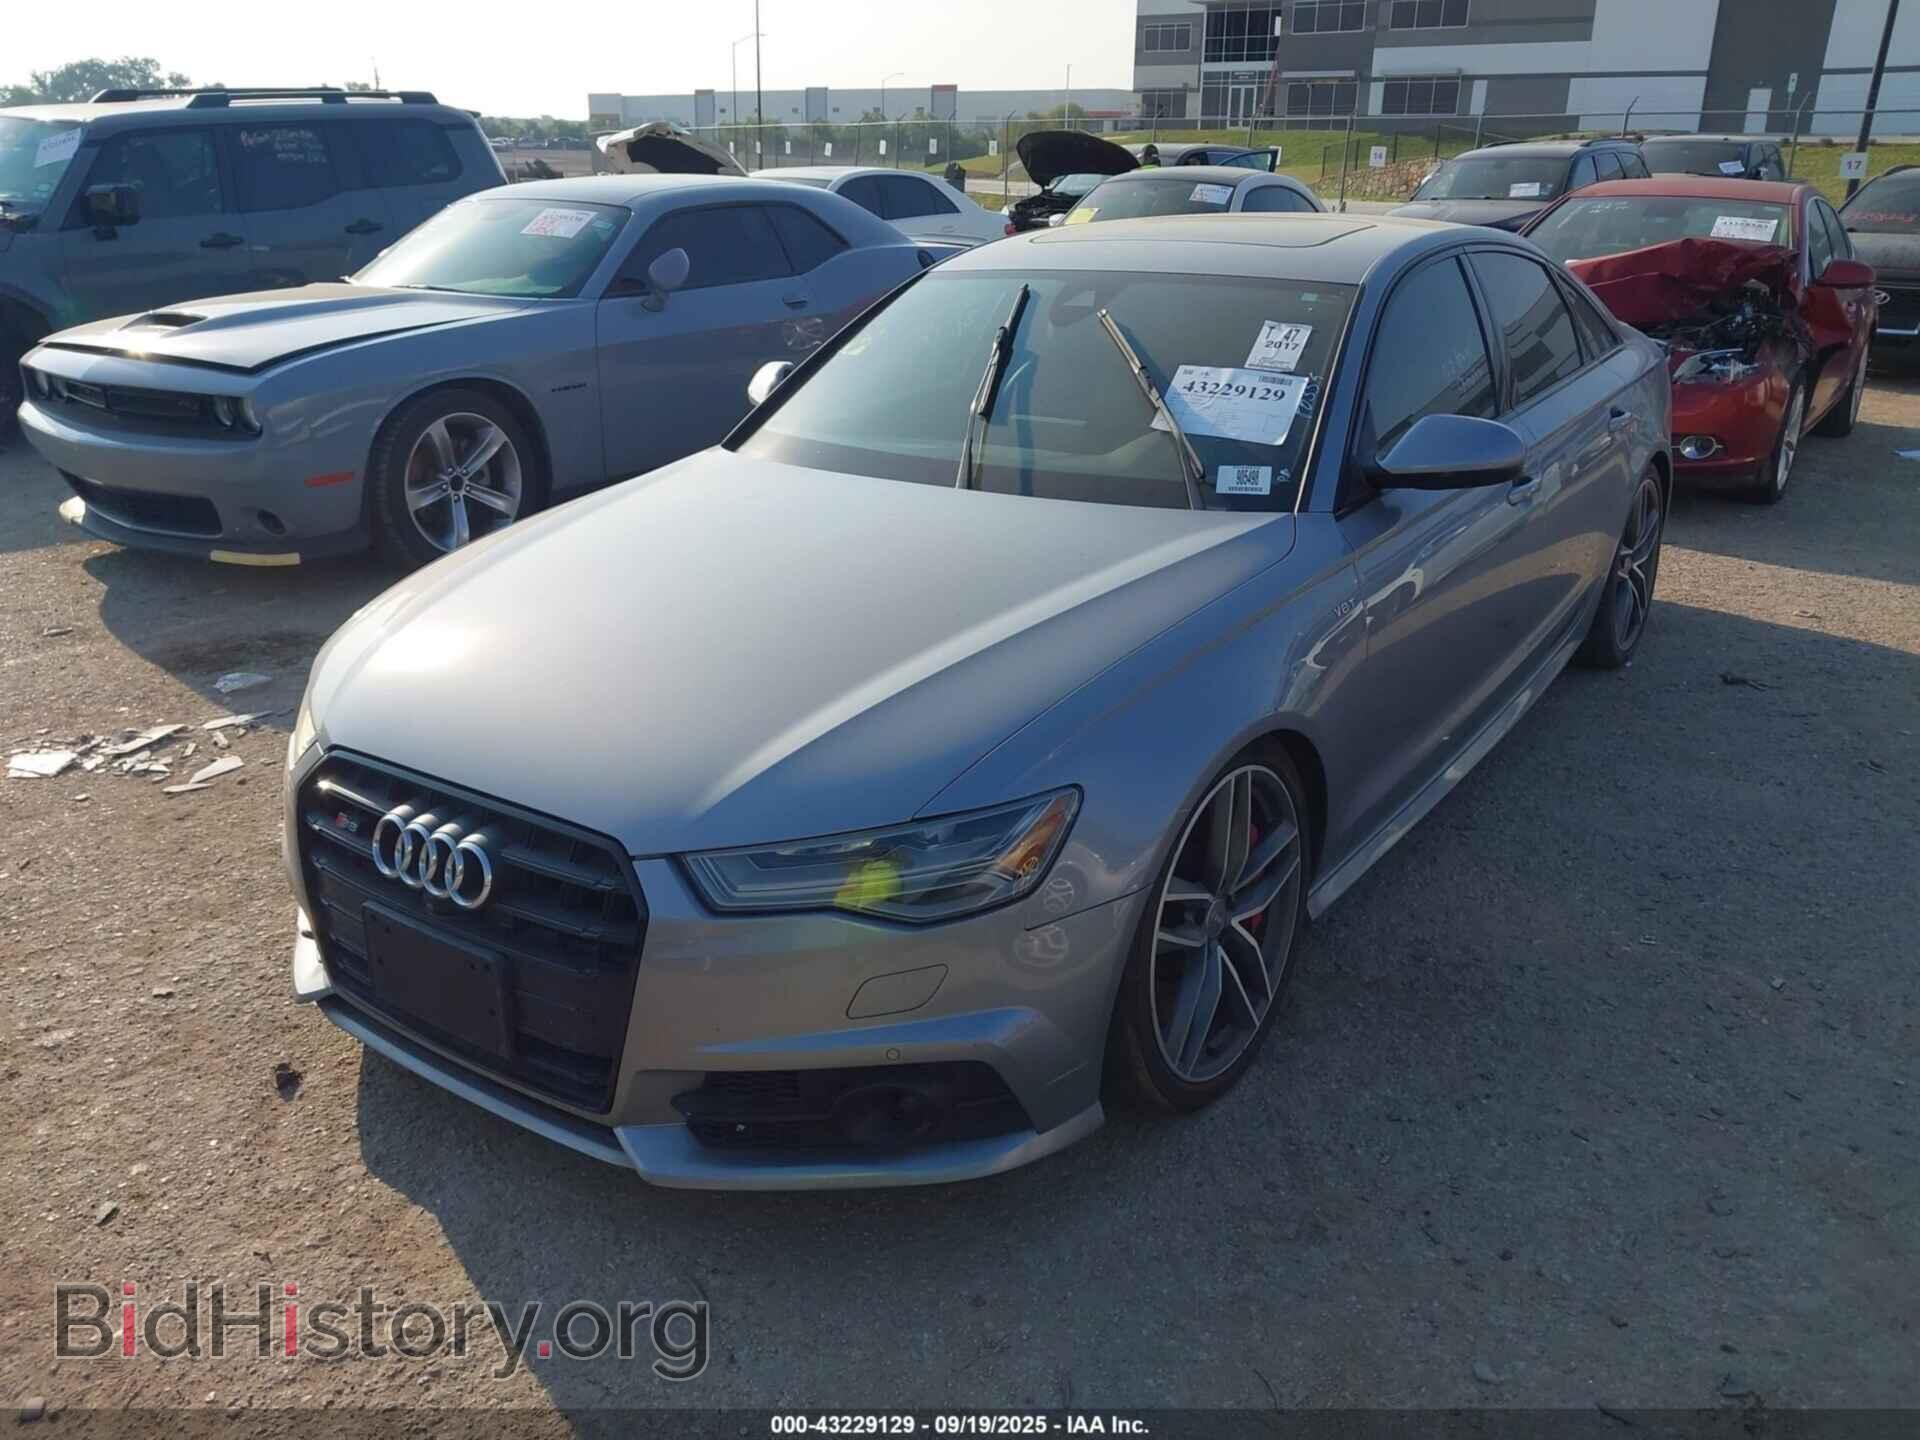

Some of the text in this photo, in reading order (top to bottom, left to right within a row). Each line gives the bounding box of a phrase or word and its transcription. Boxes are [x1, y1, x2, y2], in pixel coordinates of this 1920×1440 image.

[1846, 160, 1862, 170] 17
[1283, 328, 1300, 342] 47
[1264, 340, 1300, 351] 2017
[1182, 380, 1286, 402] 43229129
